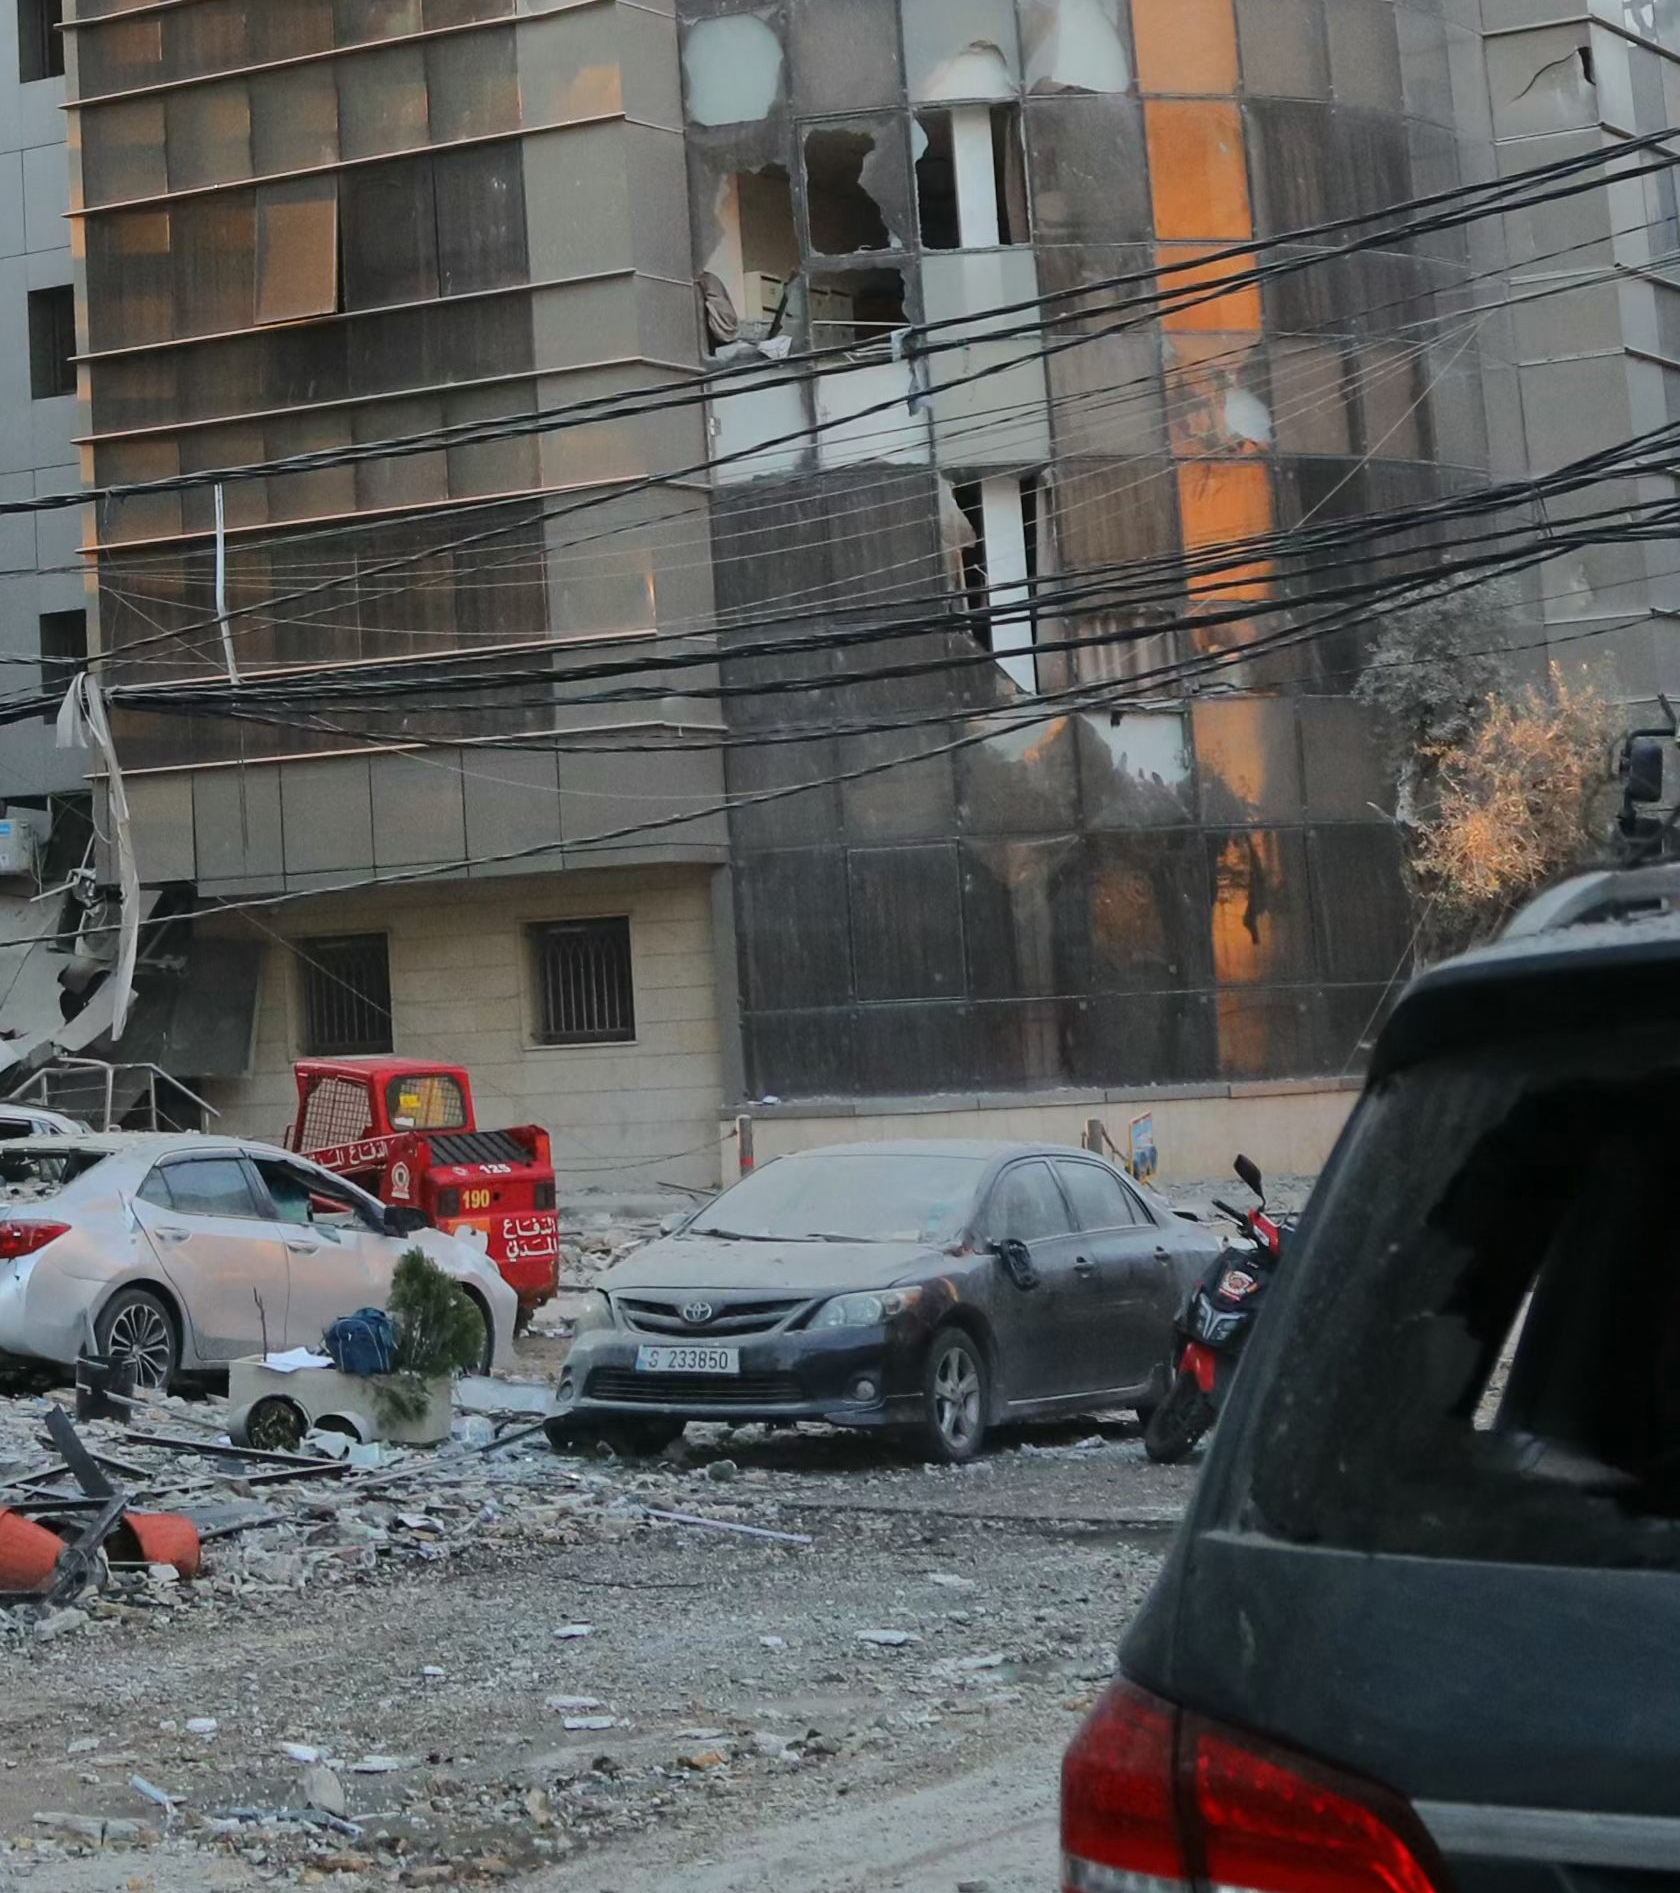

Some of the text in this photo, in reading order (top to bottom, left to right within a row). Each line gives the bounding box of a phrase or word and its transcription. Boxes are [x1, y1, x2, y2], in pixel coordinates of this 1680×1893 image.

[479, 1163, 511, 1175] 125
[462, 1188, 490, 1209] 190
[668, 1350, 729, 1369] 233850
